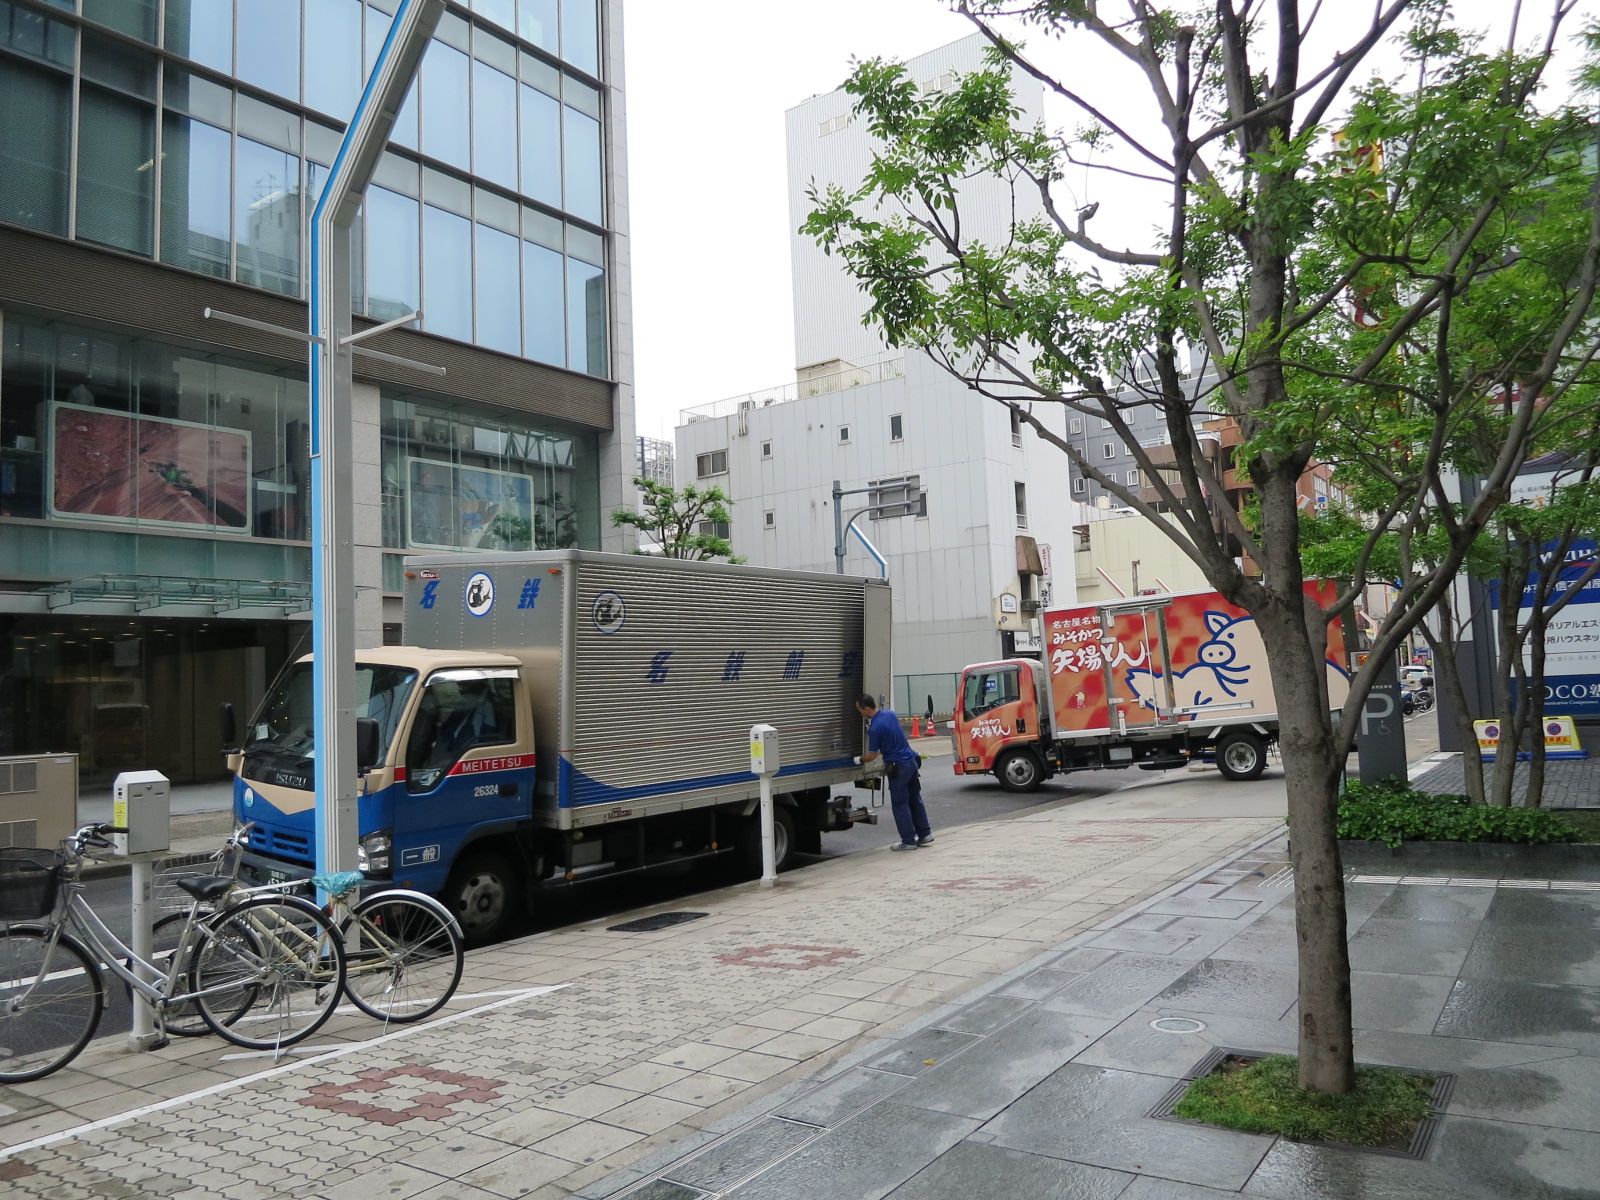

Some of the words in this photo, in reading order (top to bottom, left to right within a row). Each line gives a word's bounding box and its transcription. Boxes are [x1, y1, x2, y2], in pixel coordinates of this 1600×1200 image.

[1052, 615, 1101, 629] 名古屋名物
[1052, 628, 1104, 645] みそかつ
[1051, 640, 1146, 675] 矢場とん
[970, 724, 1011, 739] 矢場とん
[462, 757, 522, 772] MEITETSU
[474, 784, 499, 797] 26324
[406, 846, 436, 862] 一般
